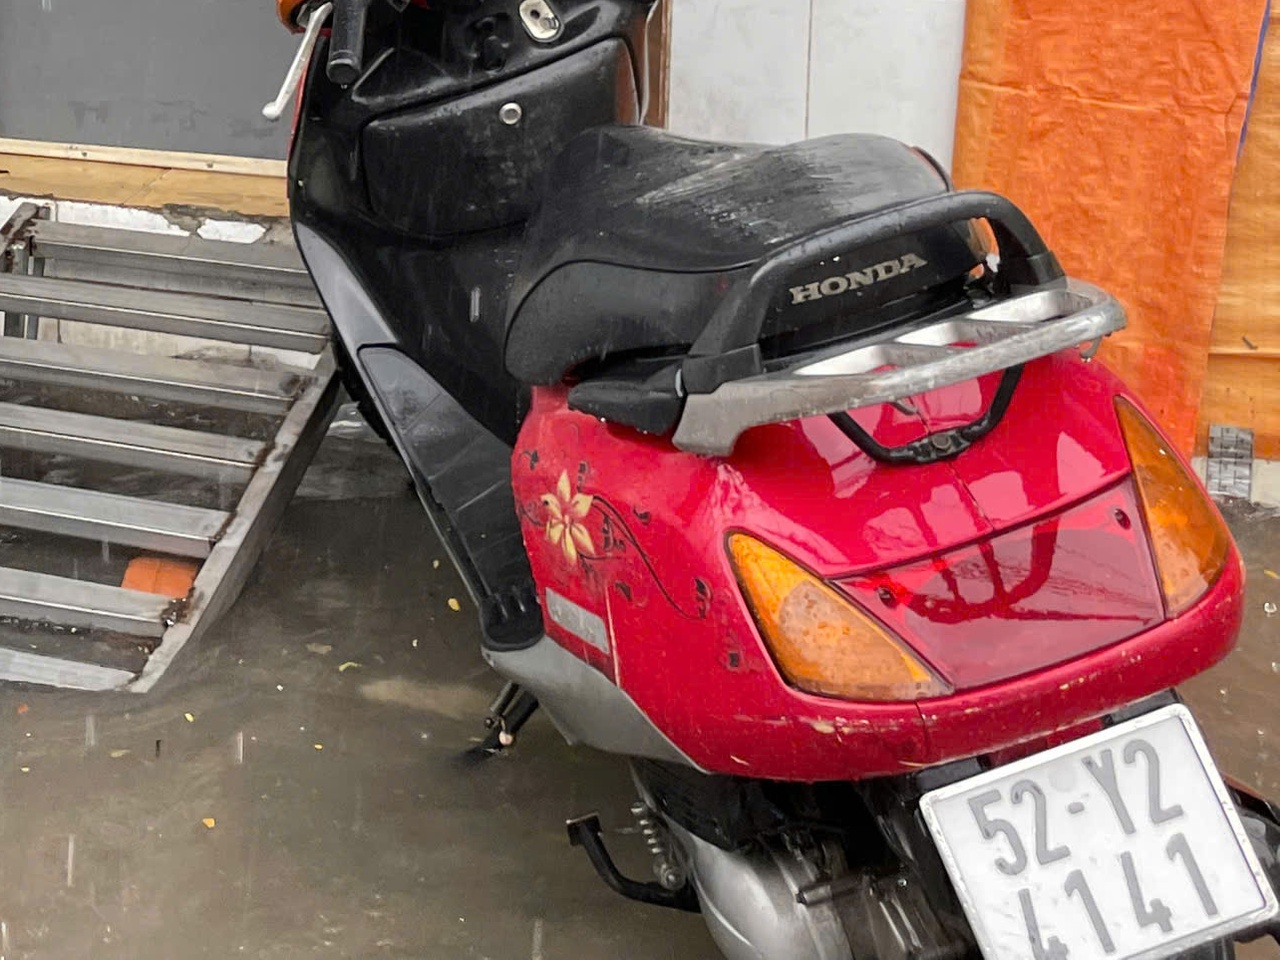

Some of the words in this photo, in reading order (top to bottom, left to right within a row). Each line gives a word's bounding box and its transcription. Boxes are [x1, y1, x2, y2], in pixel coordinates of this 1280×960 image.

[789, 253, 928, 304] HONDA
[968, 739, 1184, 876] 52-Y2
[1018, 832, 1218, 960] 4141
